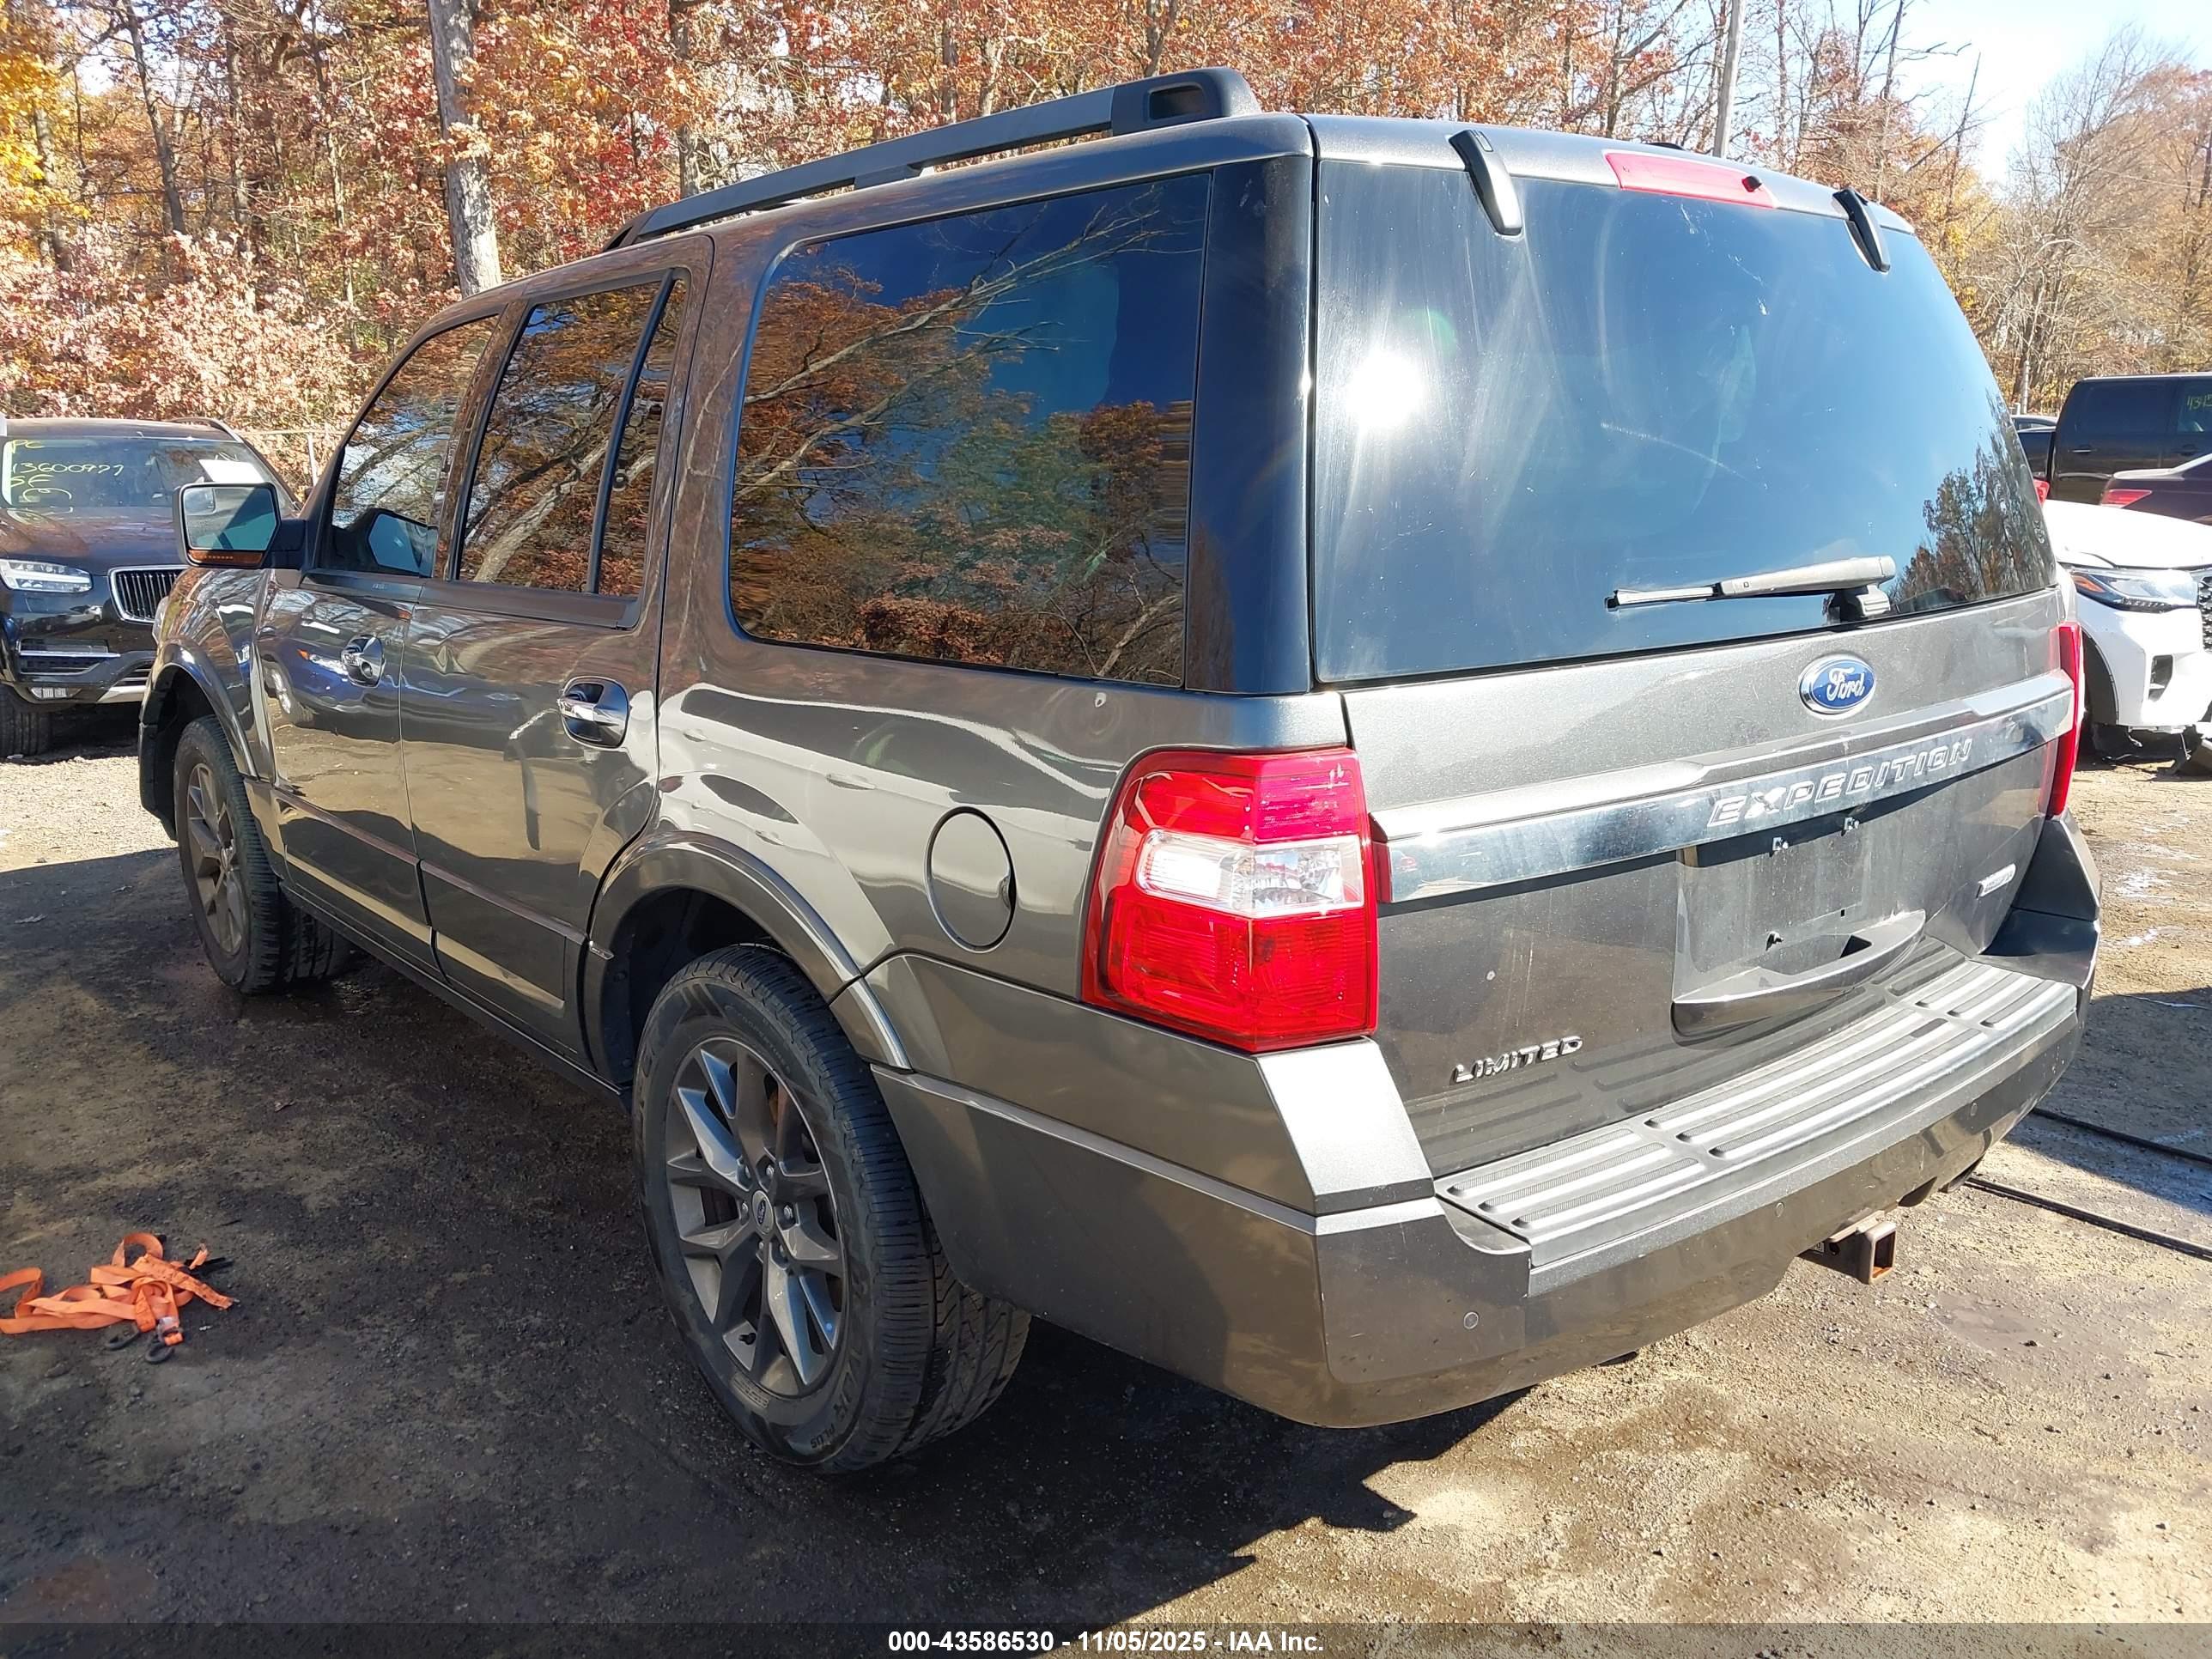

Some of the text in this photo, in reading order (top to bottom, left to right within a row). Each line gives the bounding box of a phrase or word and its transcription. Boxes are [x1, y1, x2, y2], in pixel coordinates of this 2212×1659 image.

[1826, 667, 1865, 702] Ford
[1707, 738, 1973, 828] EXPEDITION
[1449, 1035, 1583, 1085] LIMITED
